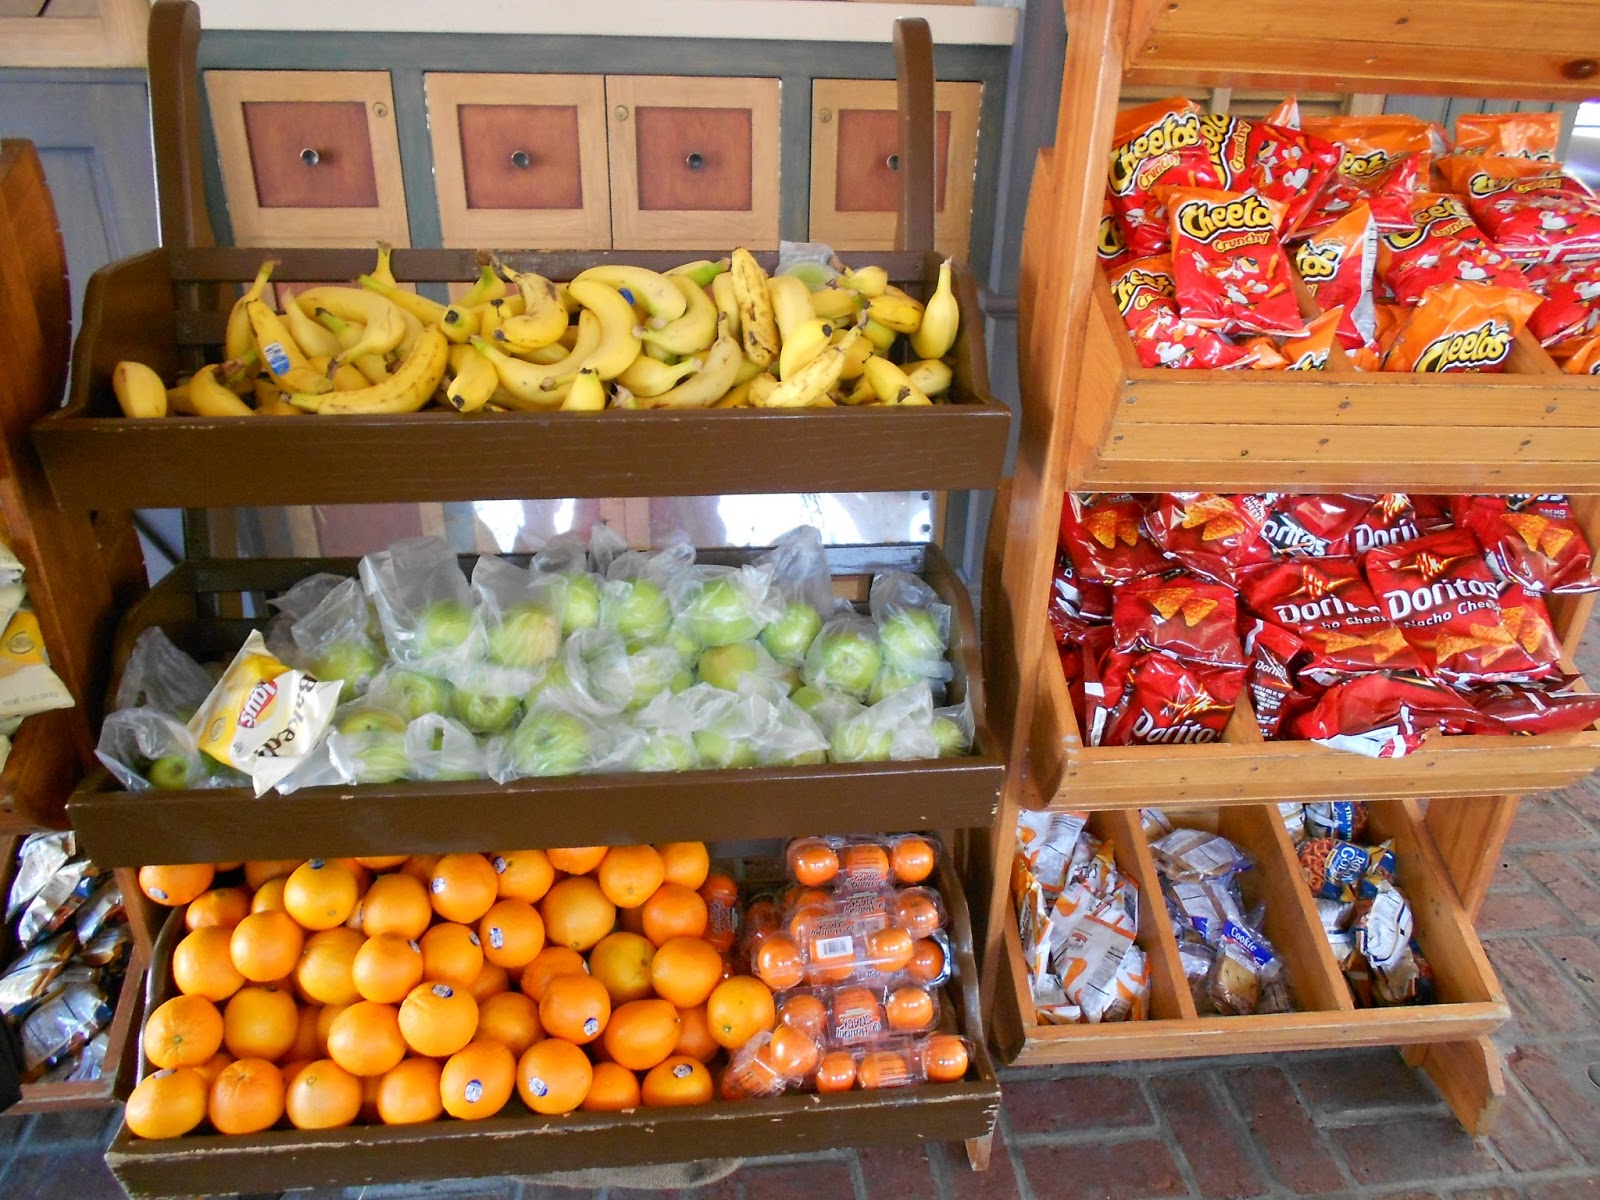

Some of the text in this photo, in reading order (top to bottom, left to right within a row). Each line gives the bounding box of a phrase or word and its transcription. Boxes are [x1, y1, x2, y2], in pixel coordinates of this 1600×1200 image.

[1108, 117, 1199, 192] Cheetos
[1228, 119, 1251, 174] Crunchy
[1137, 151, 1182, 189] Crunchy
[1178, 194, 1273, 241] Cheeto
[1212, 232, 1270, 253] Crunchy
[1260, 512, 1333, 557] oritos
[1353, 519, 1420, 552] Dorit
[1383, 578, 1500, 620] Doritos
[1132, 707, 1222, 744] Dorito
[1230, 925, 1258, 953] Cookie
